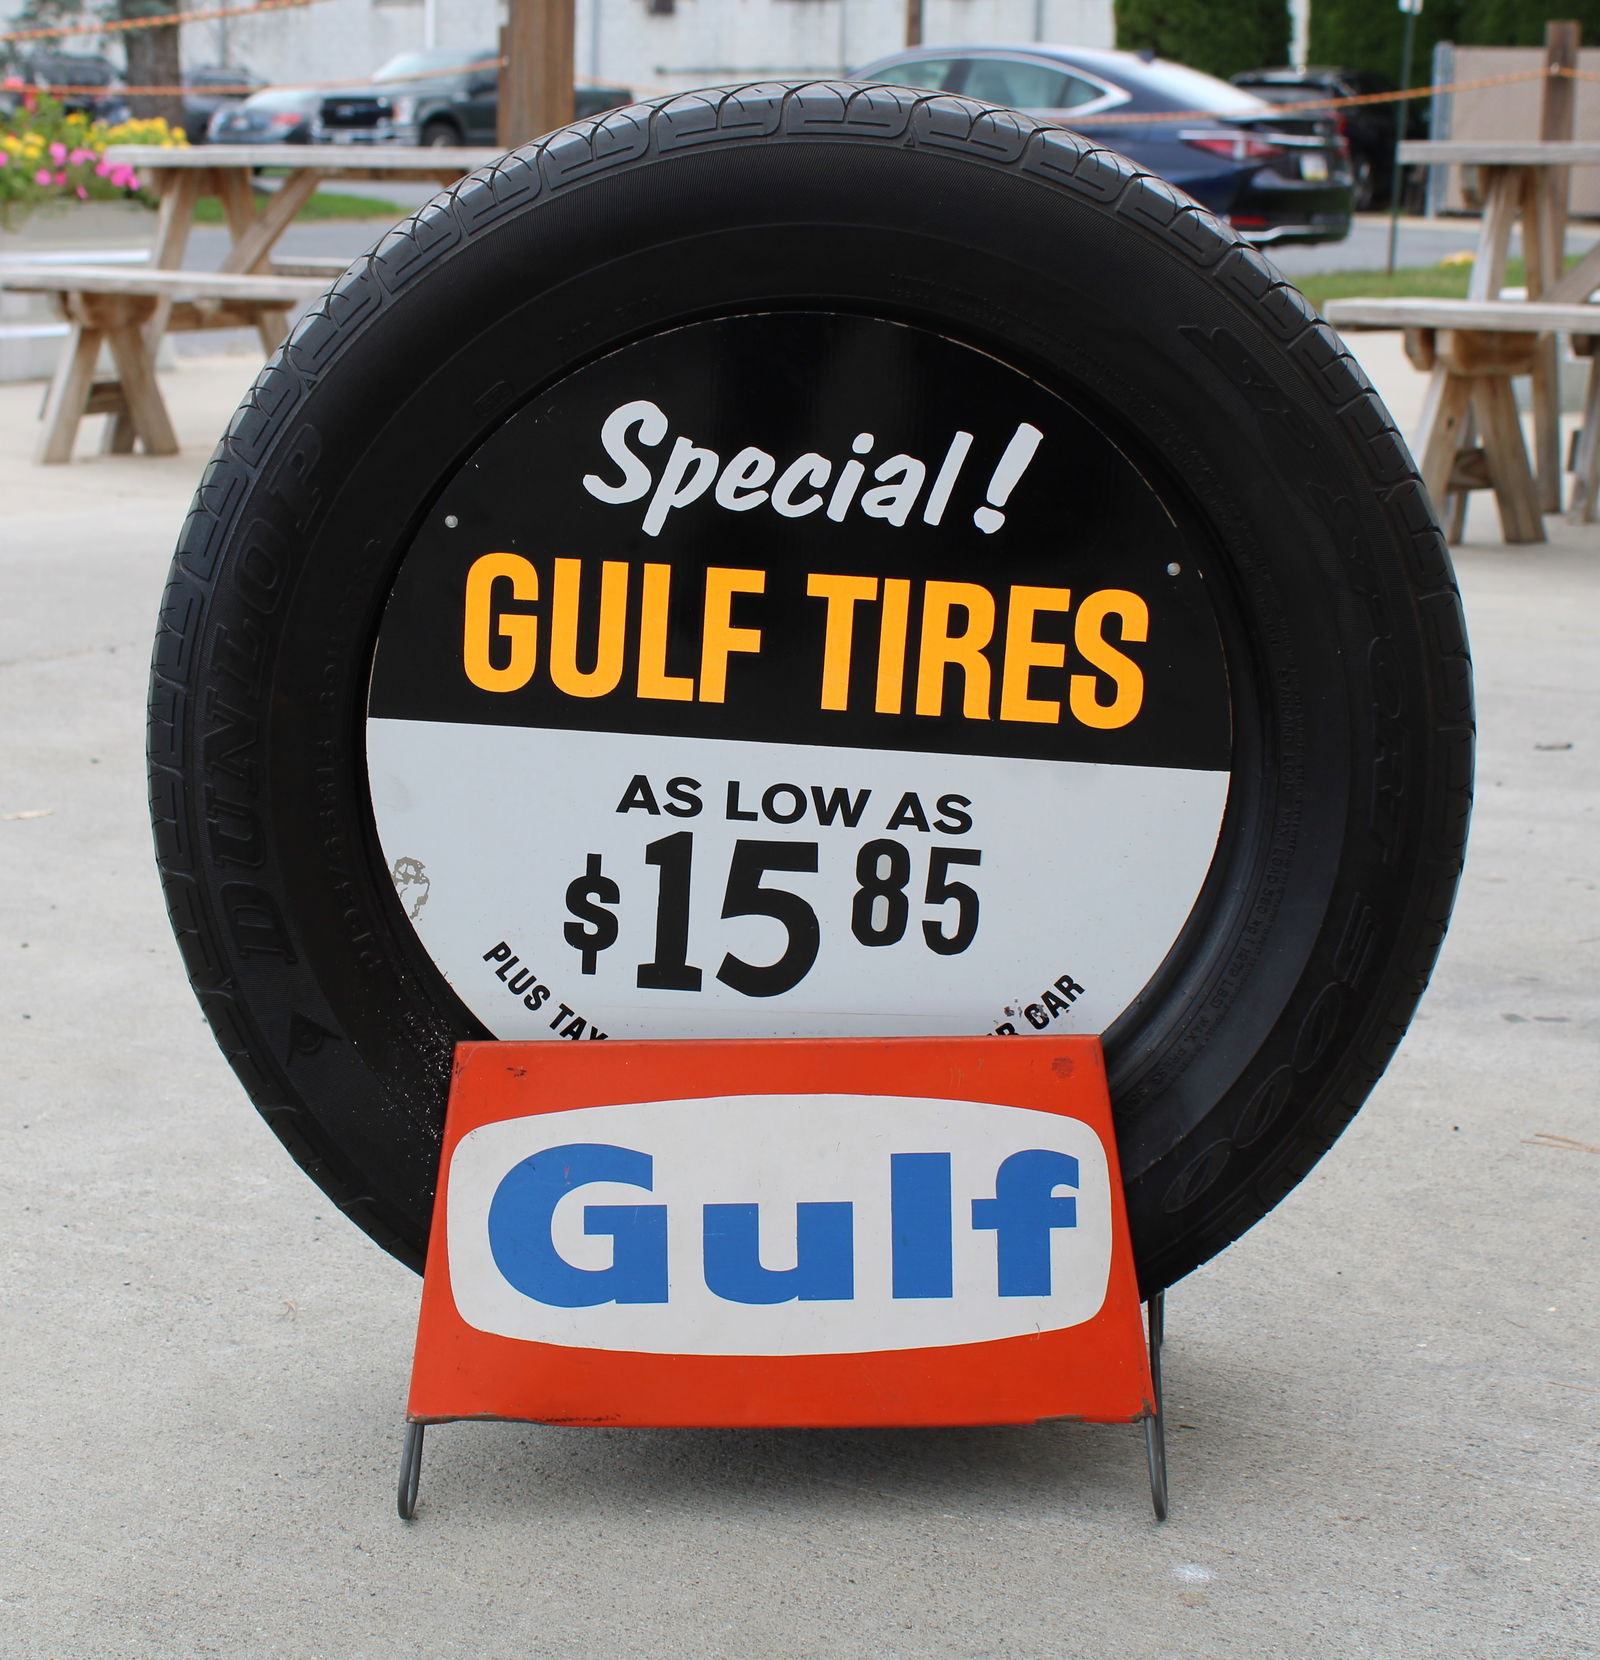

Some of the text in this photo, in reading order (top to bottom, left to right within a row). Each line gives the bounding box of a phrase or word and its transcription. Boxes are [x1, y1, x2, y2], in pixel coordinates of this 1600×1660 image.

[201, 423, 322, 963] DUNLOP
[463, 553, 766, 703] GULF
[807, 574, 1150, 729] TIRES
[616, 774, 974, 835] AS LOW AS
[482, 941, 551, 1011] PLUS
[563, 831, 983, 998] $15 85
[1024, 974, 1086, 1030] CAR
[487, 1142, 1080, 1309] Gulf
